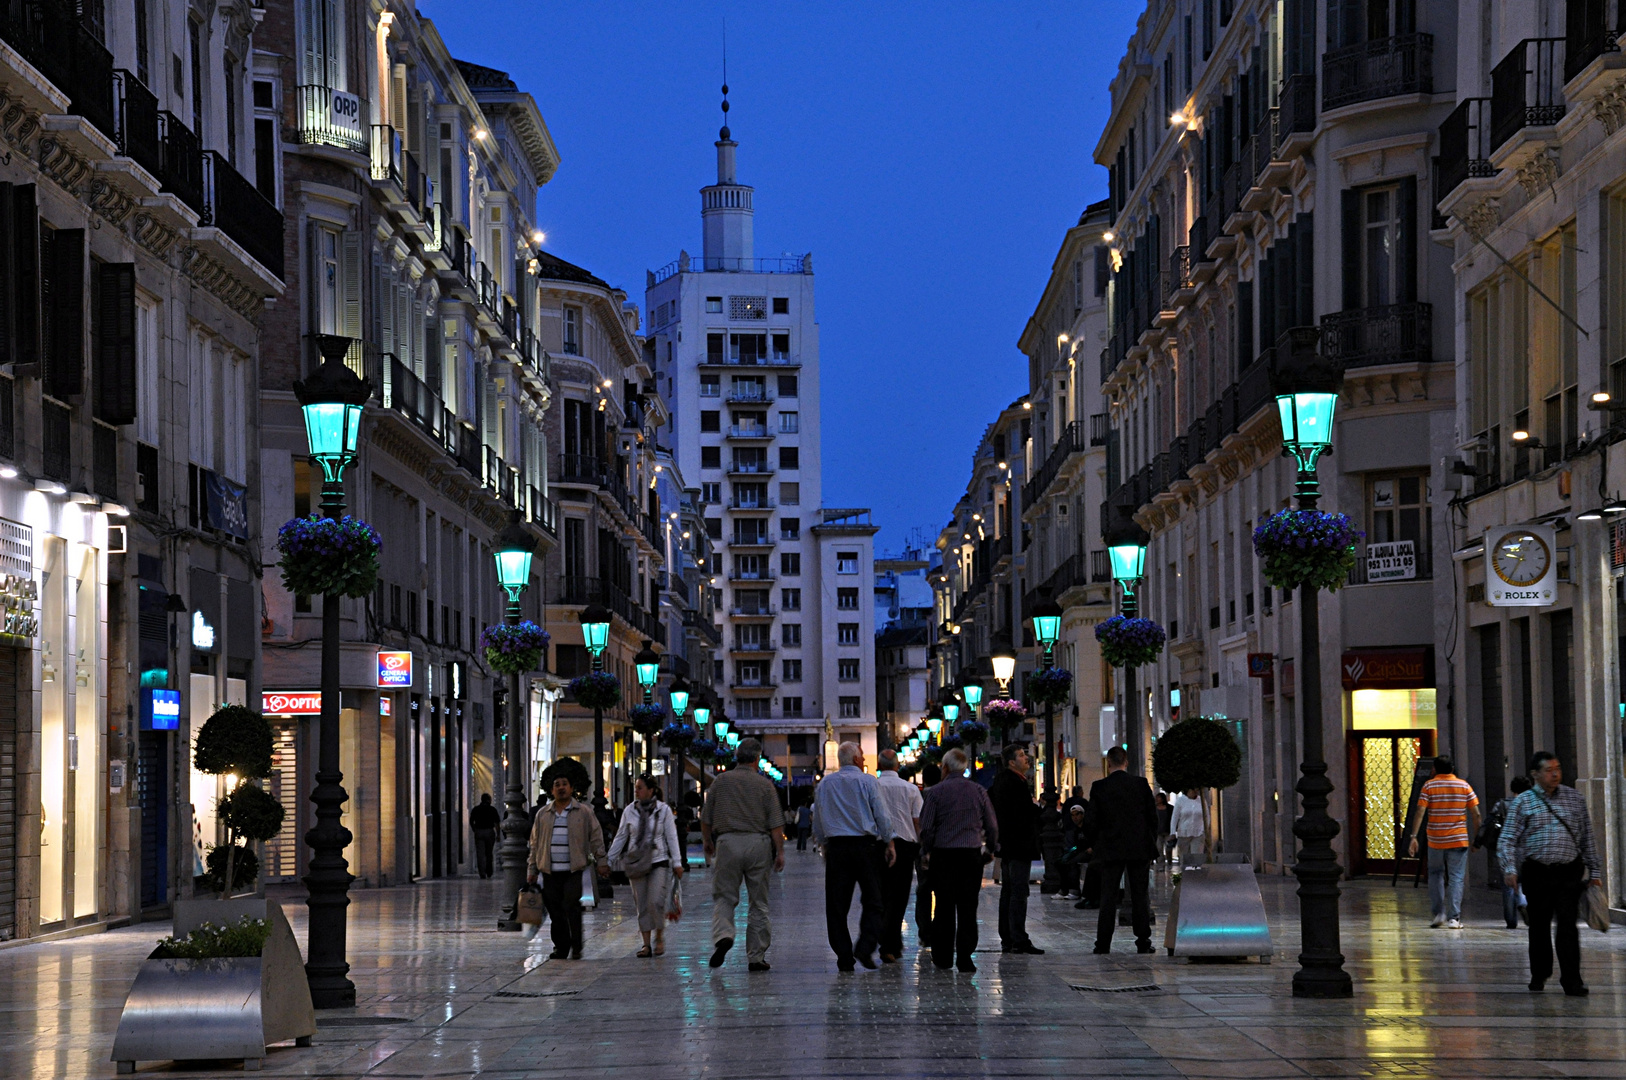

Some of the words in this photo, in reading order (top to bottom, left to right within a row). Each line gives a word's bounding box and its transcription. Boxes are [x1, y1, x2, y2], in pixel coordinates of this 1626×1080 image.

[334, 96, 358, 117] ORP
[1396, 544, 1413, 556] LOCAL
[1369, 560, 1380, 569] 952
[1383, 559, 1390, 568] 12
[1393, 558, 1401, 566] 12
[1404, 557, 1413, 566] 05
[1505, 591, 1540, 600] ROLEX
[1366, 660, 1422, 678] CajaSur
[290, 698, 322, 709] OPTIC
